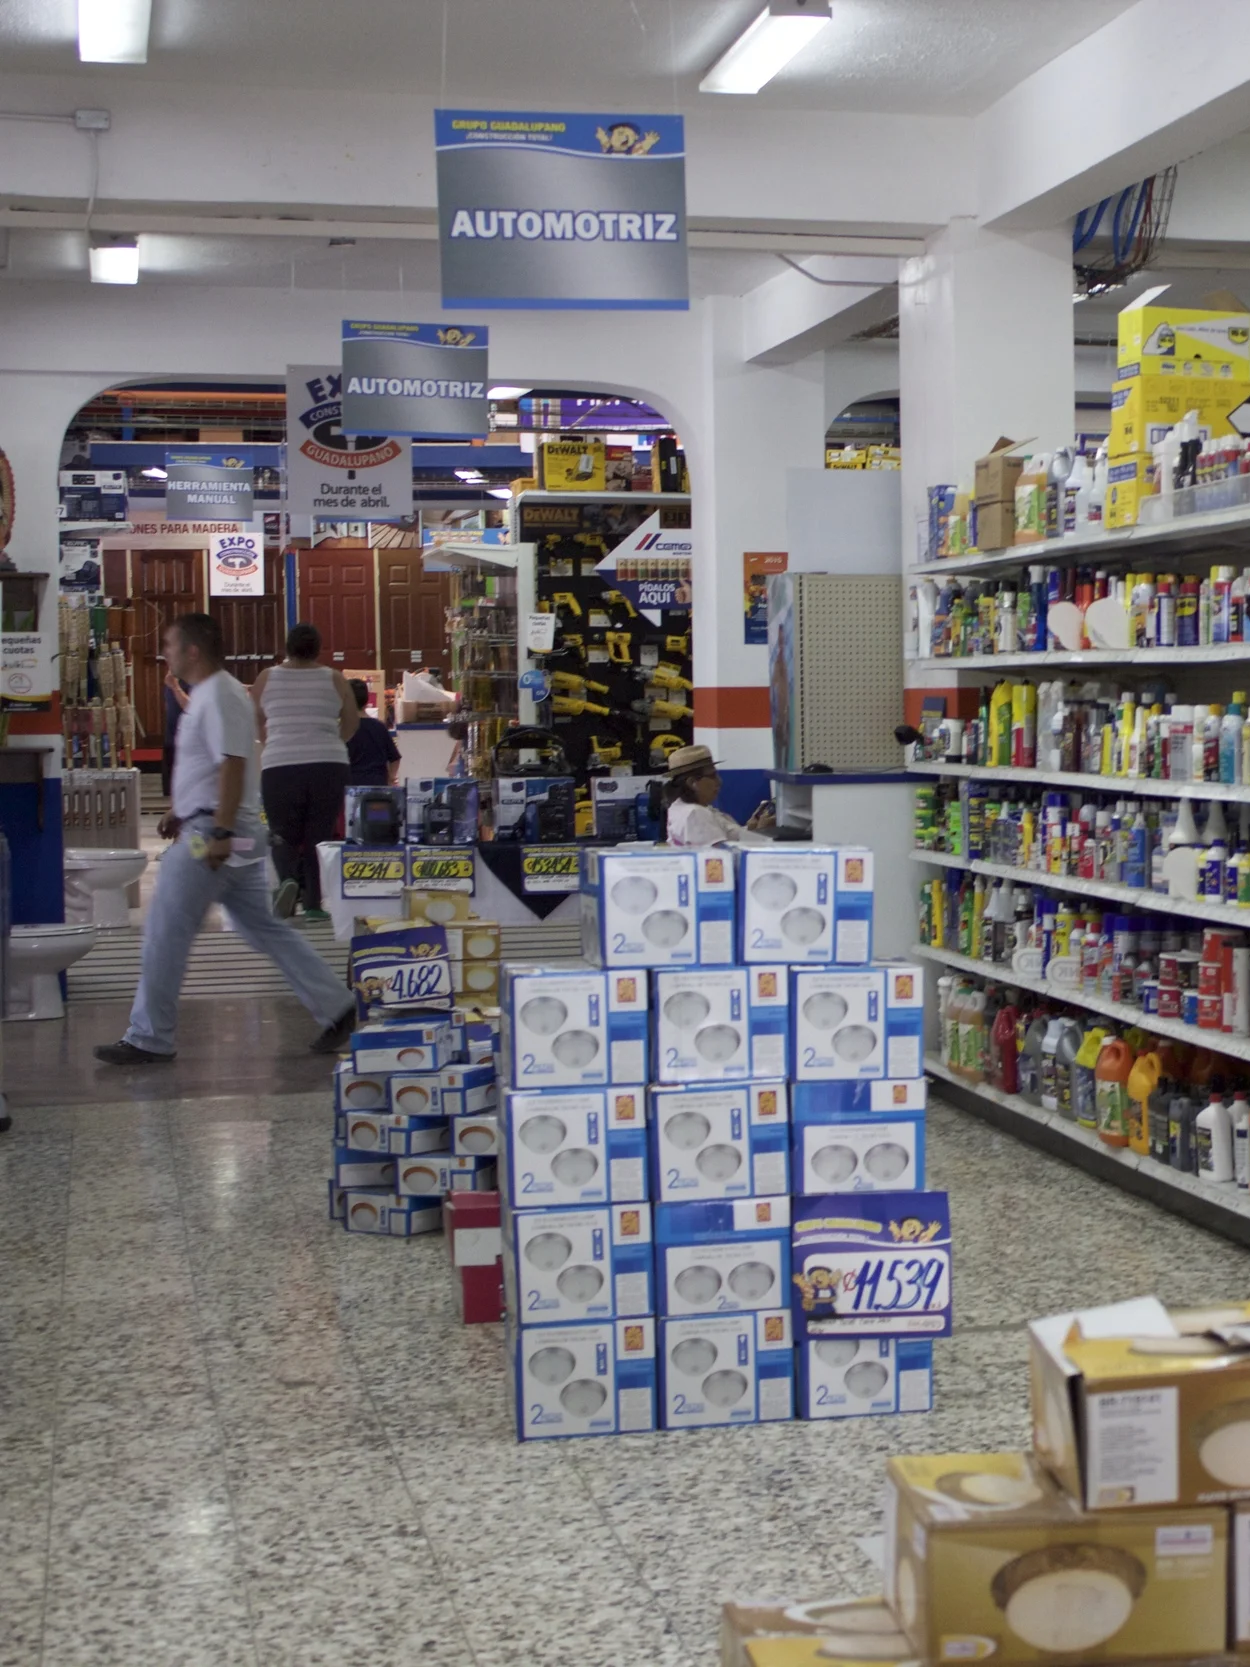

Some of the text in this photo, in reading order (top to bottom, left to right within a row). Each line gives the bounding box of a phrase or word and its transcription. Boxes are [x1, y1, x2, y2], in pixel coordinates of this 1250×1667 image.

[451, 210, 678, 241] AUTOMOTRIZ
[347, 376, 484, 399] AUTOMOTRIZ
[306, 446, 394, 467] GUADALUPANO
[167, 481, 251, 492] HERRAMIENTA
[321, 483, 382, 495] Durante el
[187, 494, 237, 504] MANUAL
[313, 496, 390, 507] mes de abril.
[160, 524, 190, 533] PARA
[192, 524, 239, 533] MADERA
[218, 536, 255, 549] EXPO
[0, 635, 41, 646] equeñas
